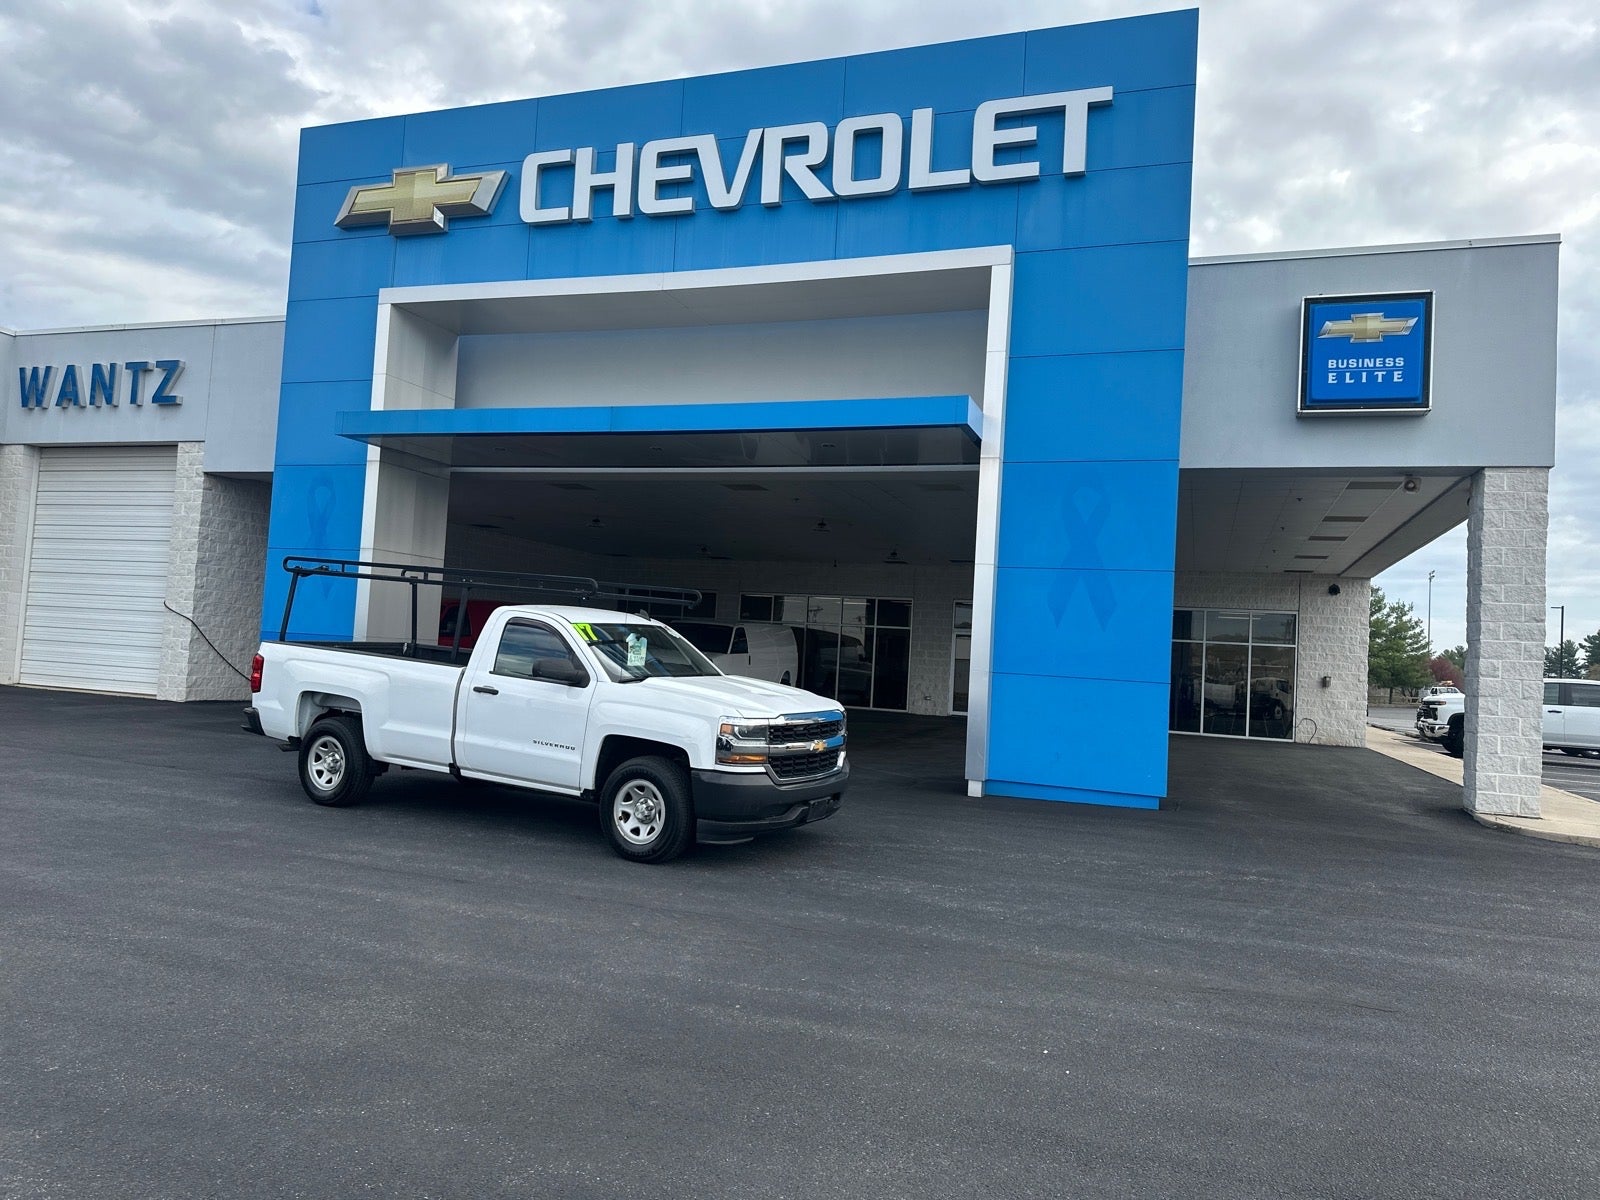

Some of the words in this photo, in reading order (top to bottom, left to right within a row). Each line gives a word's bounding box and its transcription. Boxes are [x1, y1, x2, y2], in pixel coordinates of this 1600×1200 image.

[520, 86, 1113, 224] CHEVROLET
[1327, 371, 1404, 384] ELITE
[1328, 357, 1404, 368] BUSINESS
[19, 360, 185, 409] WANTZ
